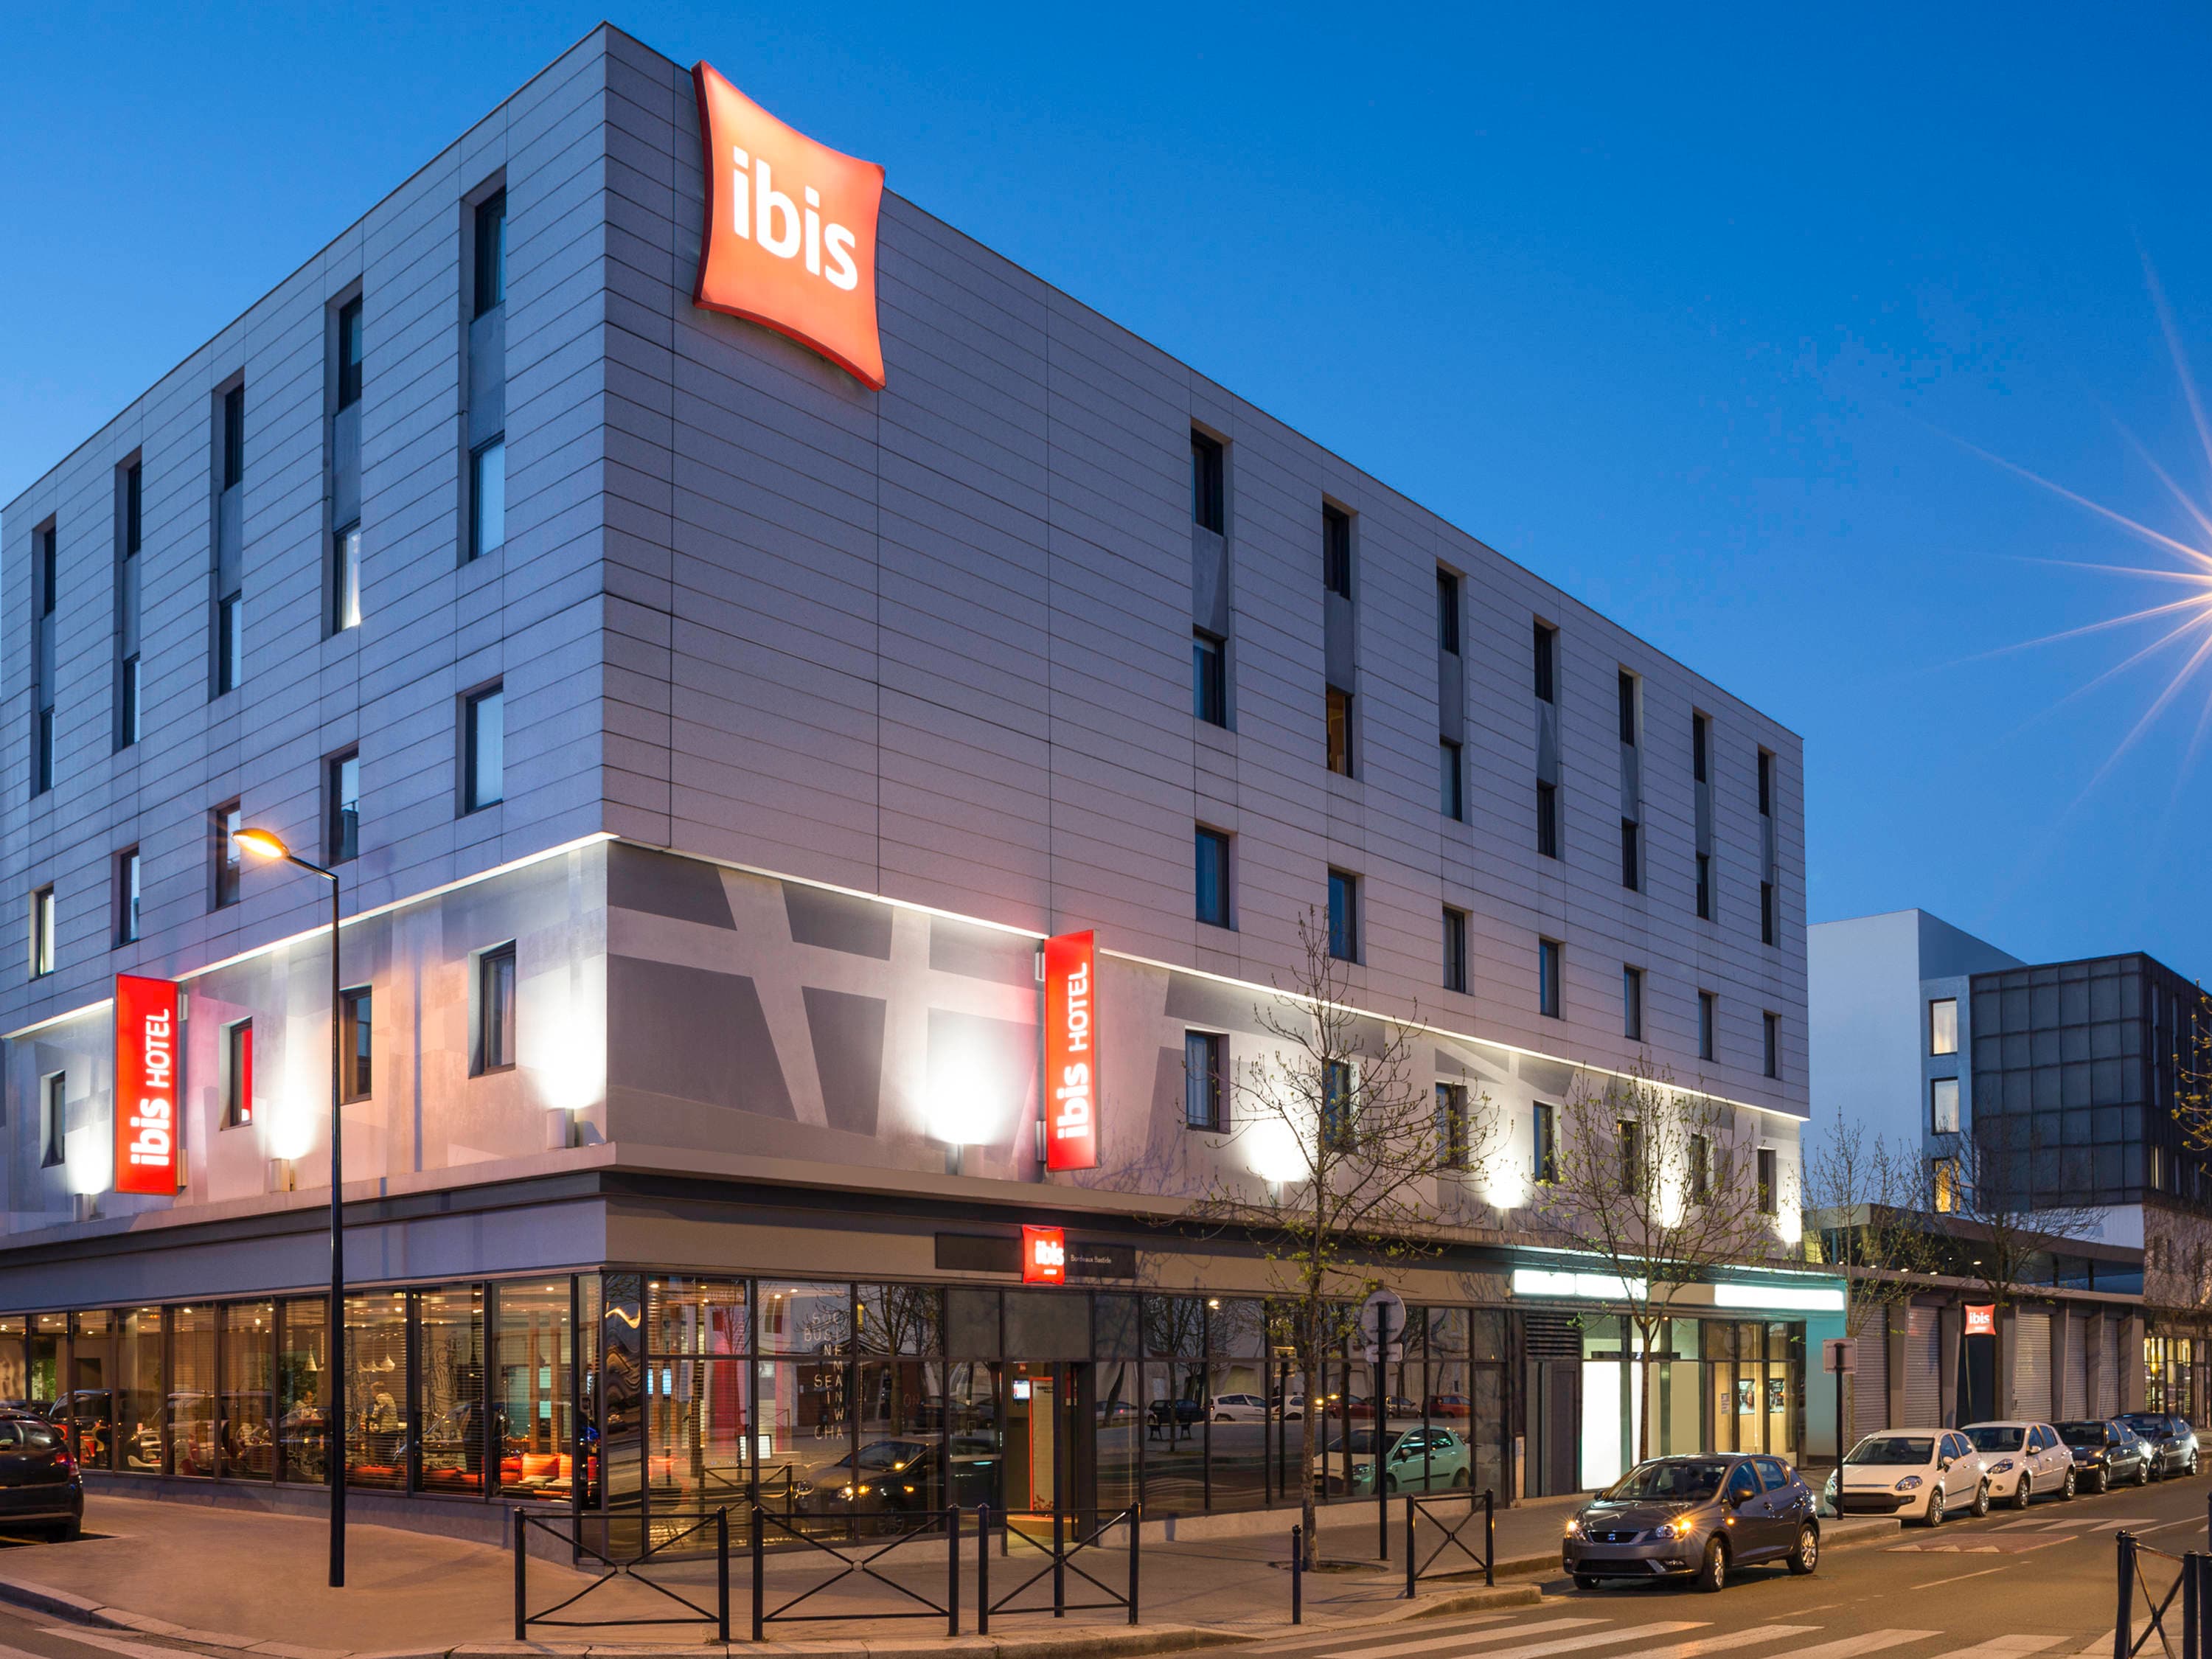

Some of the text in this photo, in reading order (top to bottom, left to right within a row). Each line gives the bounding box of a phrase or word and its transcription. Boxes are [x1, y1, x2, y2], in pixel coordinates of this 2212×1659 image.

[734, 145, 858, 291] ibis
[130, 1008, 170, 1166] ibis HOTEL
[1057, 961, 1089, 1139] ibis HOTEL
[1035, 1240, 1065, 1266] ibis
[1071, 1254, 1111, 1264] Bordeaux Bastide
[1969, 1312, 1990, 1324] ibis
